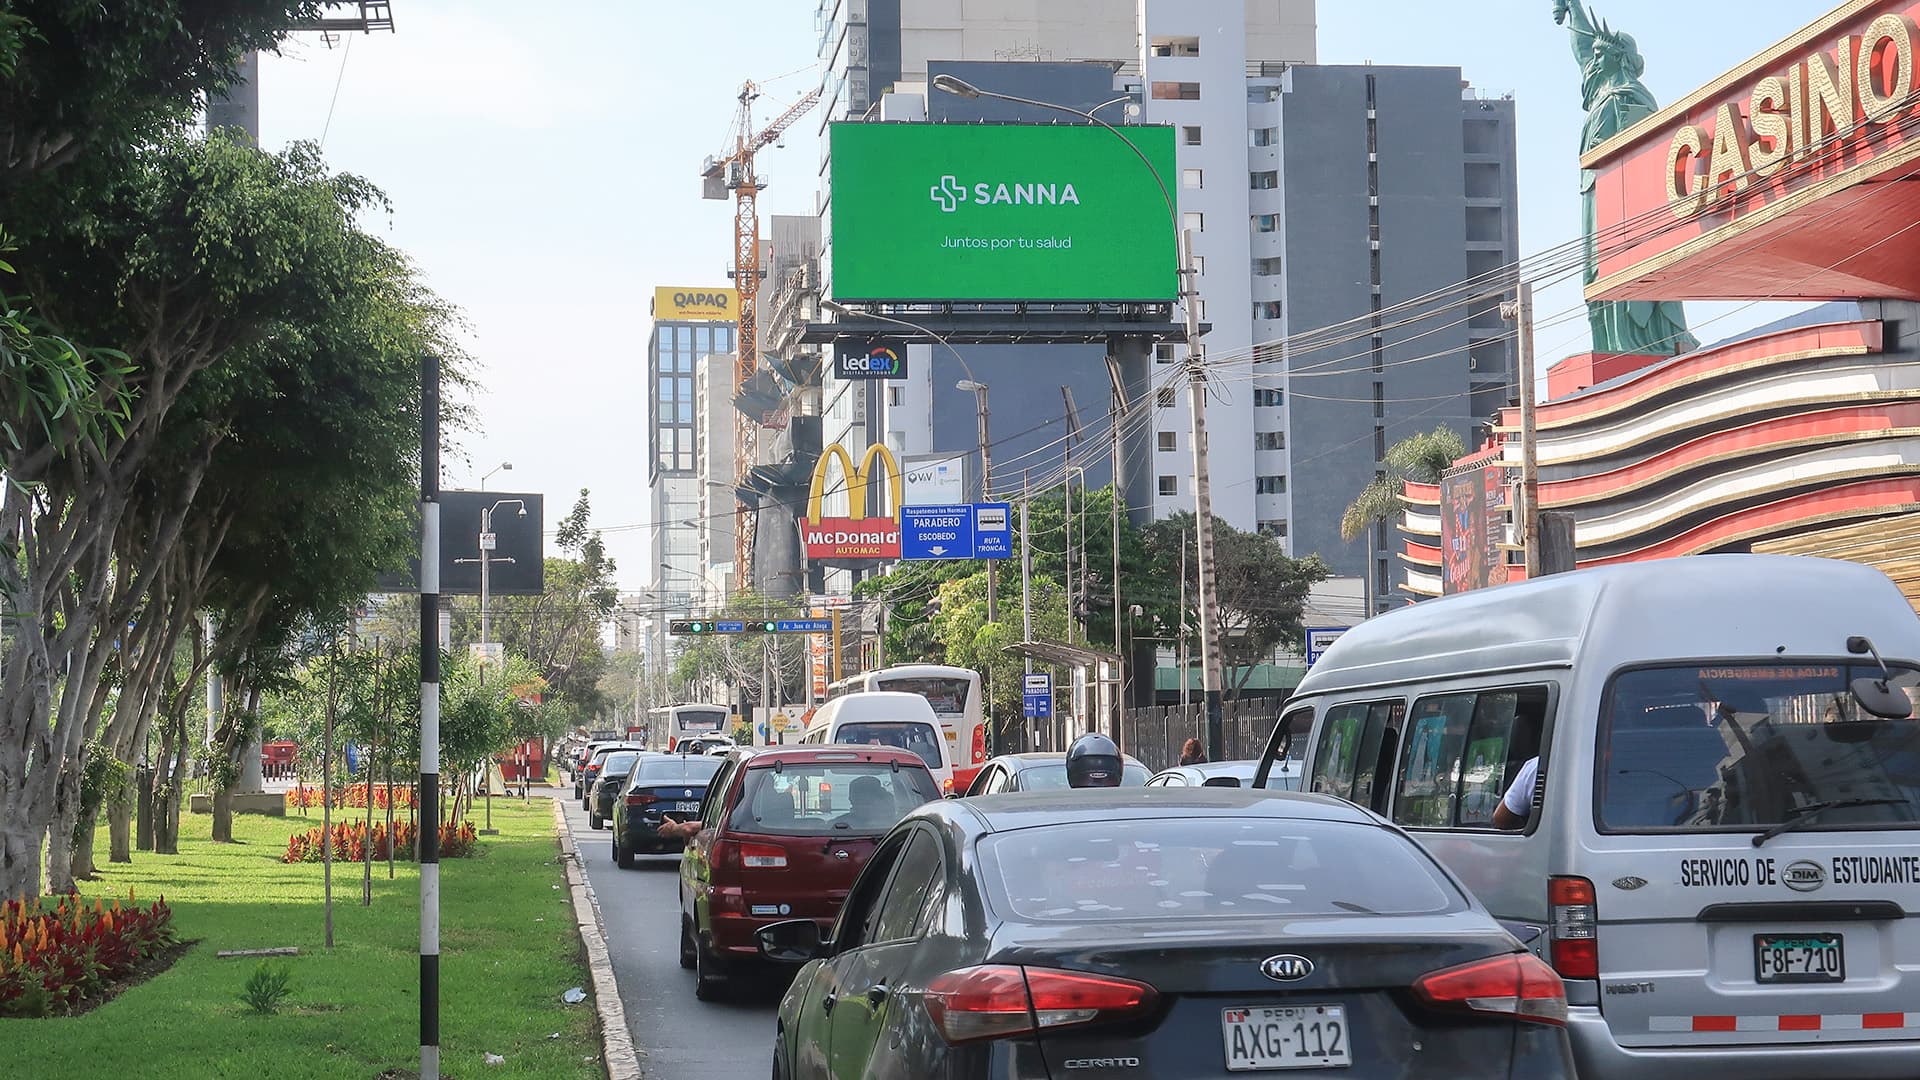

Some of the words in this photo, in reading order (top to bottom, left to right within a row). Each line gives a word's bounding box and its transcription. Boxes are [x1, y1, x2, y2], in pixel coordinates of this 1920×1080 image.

[1665, 13, 1914, 219] CASINO
[974, 183, 1080, 205] SANNA
[940, 236, 988, 248] Juntos
[991, 238, 1016, 250] por
[1018, 236, 1034, 248] tu
[1036, 236, 1072, 248] salud
[673, 292, 728, 309] QAPAQ
[842, 353, 891, 370] ledex
[914, 517, 960, 528] PARADERO
[918, 532, 956, 541] ESCOBEDO
[984, 537, 1001, 545] RUTA
[1681, 859, 1749, 887] SERVICIO
[1756, 859, 1776, 885] DE
[1792, 870, 1819, 880] DIM
[1270, 960, 1306, 977] KIA
[1761, 948, 1838, 973] F8F-710
[1263, 1009, 1306, 1021] PERU
[1232, 1021, 1344, 1059] AXG-112
[1064, 1057, 1139, 1069] CERATO
